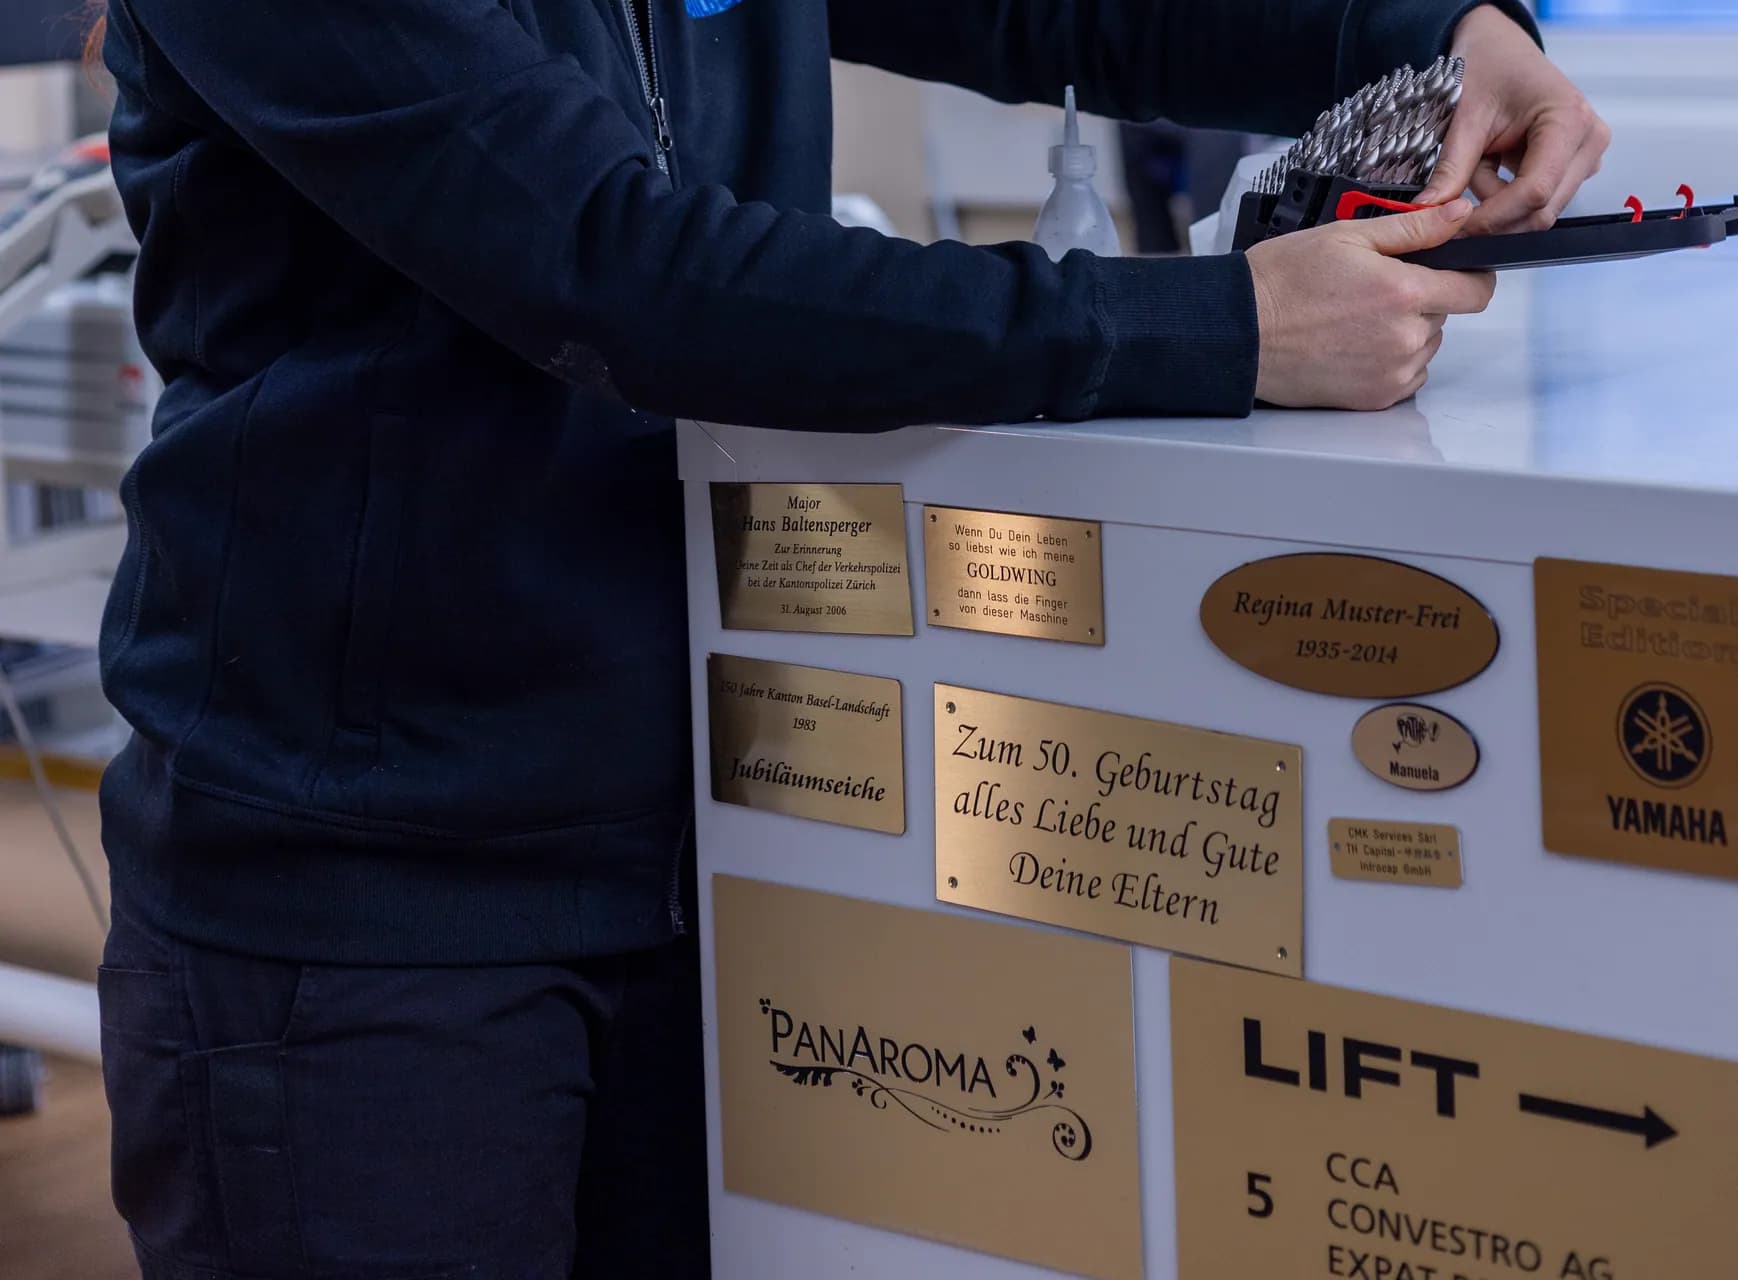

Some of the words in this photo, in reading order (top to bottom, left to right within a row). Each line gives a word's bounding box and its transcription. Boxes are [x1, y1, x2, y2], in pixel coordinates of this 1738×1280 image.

[787, 496, 822, 512] Major
[742, 515, 776, 532] Hans
[782, 516, 872, 537] Baltensperger
[954, 524, 983, 538] Wenn
[989, 527, 1002, 540] Du
[1008, 529, 1031, 543] Dein
[1036, 533, 1068, 547] Leben
[774, 543, 790, 554] Zur
[793, 543, 842, 557] Erinnerung
[948, 542, 960, 551] so
[966, 541, 993, 554] liebst
[999, 546, 1016, 557] wie
[1022, 548, 1038, 559] ich
[1043, 552, 1075, 563] meine
[761, 560, 779, 571] Zeit
[780, 560, 793, 571] als
[795, 560, 816, 574] Chef
[818, 561, 831, 572] der
[834, 562, 901, 576] Verkehrspolizei
[967, 562, 1057, 587] GOLDWING
[748, 576, 760, 587] bei
[763, 577, 776, 588] der
[779, 577, 843, 592] Kantonspolizei
[846, 579, 876, 590] Zürich
[793, 604, 823, 617] August
[826, 605, 847, 616] 2006
[958, 587, 982, 600] dann
[987, 590, 1009, 603] lass
[1014, 593, 1029, 605] die
[1035, 595, 1068, 611] Finger
[1233, 591, 1313, 626] Regina
[1320, 598, 1461, 629] Muster-Frei
[959, 604, 976, 615] von
[982, 605, 1014, 620] dieser
[1020, 610, 1068, 626] Maschine
[1295, 639, 1399, 665] 1935-2014
[739, 682, 764, 698] Jahre
[767, 687, 803, 704] Kanton
[806, 693, 890, 721] Basel-Landschaft
[793, 717, 816, 731] 1983
[729, 757, 886, 802] Jubiläumseiche
[952, 723, 1023, 767] Zum
[1032, 739, 1078, 778] 50.
[1095, 750, 1281, 829] Geburtstag
[1389, 761, 1440, 782] Manuela
[953, 780, 1025, 826] alles
[1033, 798, 1116, 844] Liebe
[1127, 821, 1198, 860] und
[1202, 831, 1280, 879] Gute
[1606, 793, 1728, 847] YAMAHA
[1348, 826, 1369, 839] CMK
[1372, 828, 1413, 843] Services
[1008, 851, 1102, 901] Deine
[1111, 872, 1219, 926] Eltern
[1243, 1017, 1480, 1120] LIFT
[1326, 1151, 1400, 1196] CCA
[1246, 1171, 1275, 1219] 5
[1327, 1199, 1543, 1272] CONVESTRO
[1560, 1250, 1614, 1280] AG
